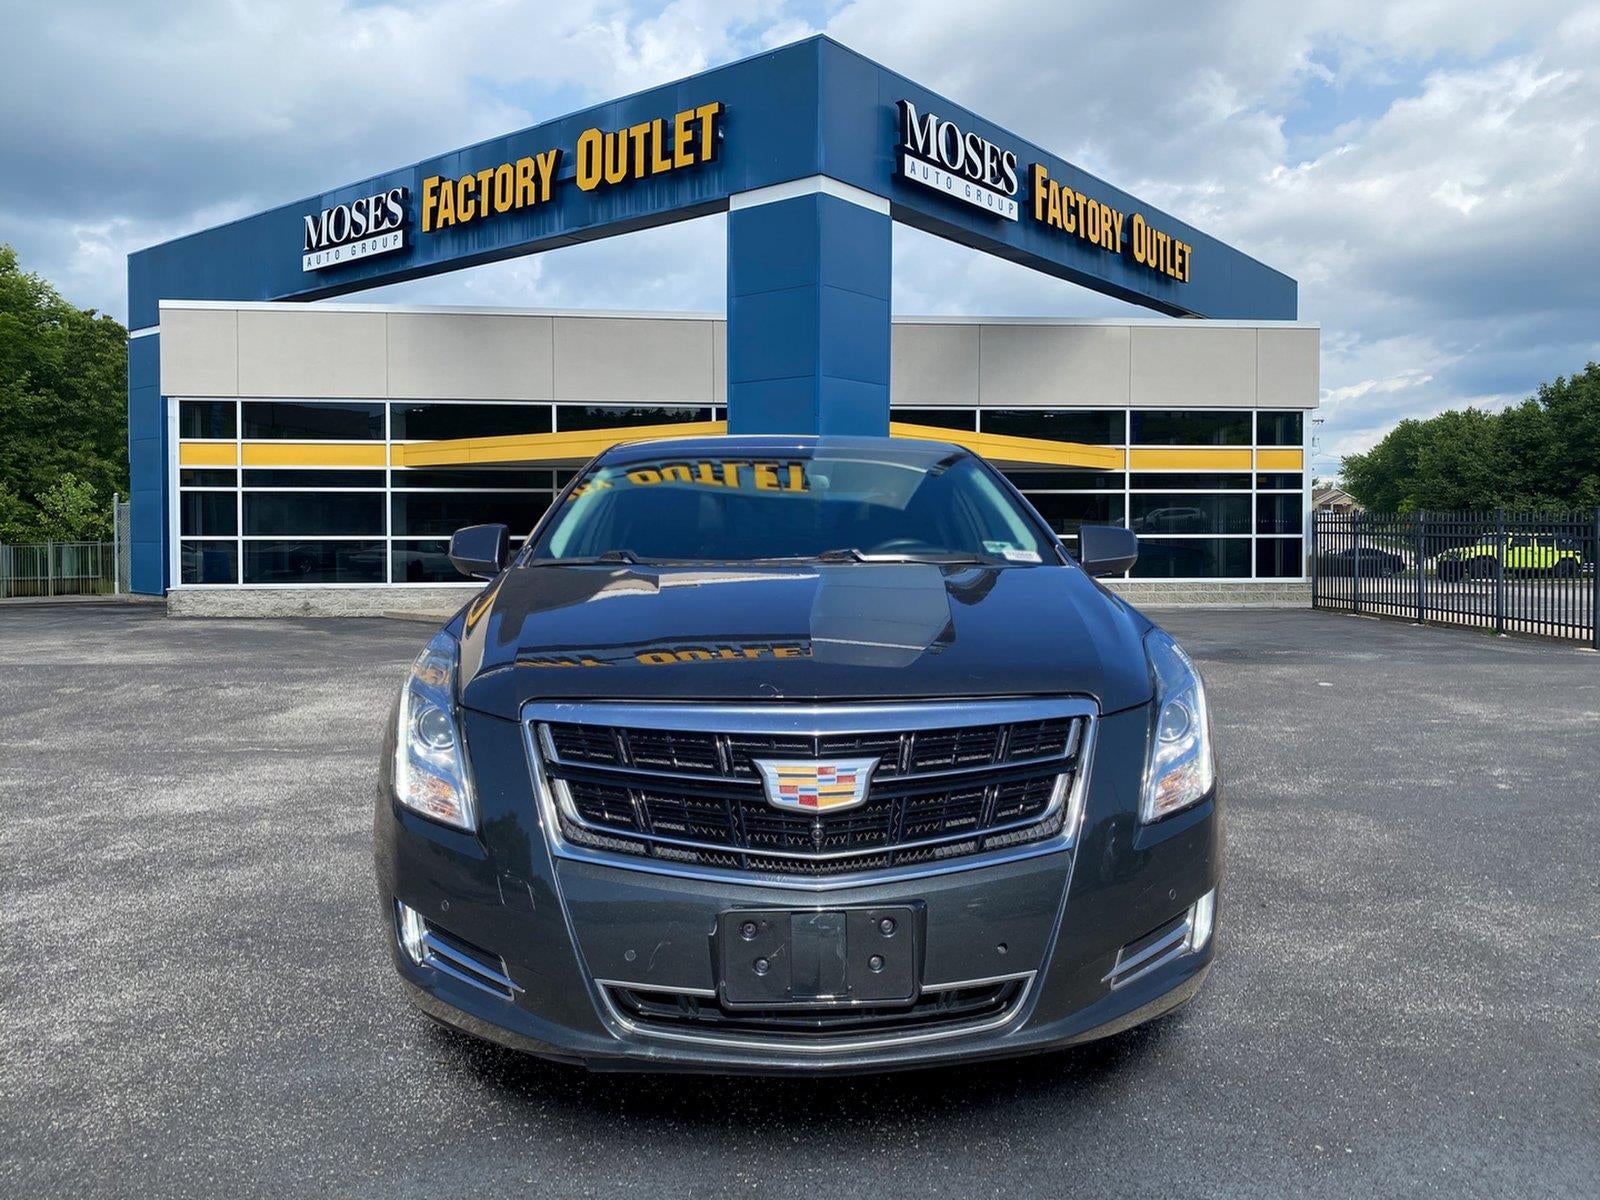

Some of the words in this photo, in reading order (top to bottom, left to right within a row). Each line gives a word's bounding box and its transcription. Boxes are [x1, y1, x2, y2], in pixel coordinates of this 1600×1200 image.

[421, 148, 558, 233] FACTORY
[576, 101, 721, 192] OUTLET
[903, 99, 1018, 196] MOSES
[910, 160, 953, 190] AUTO
[965, 184, 1014, 214] GROUP
[303, 188, 403, 251] MOSES
[307, 249, 340, 268] AUTO
[350, 234, 399, 257] GROUP
[1034, 162, 1124, 254] FACTORY
[1130, 212, 1192, 283] OUTLET
